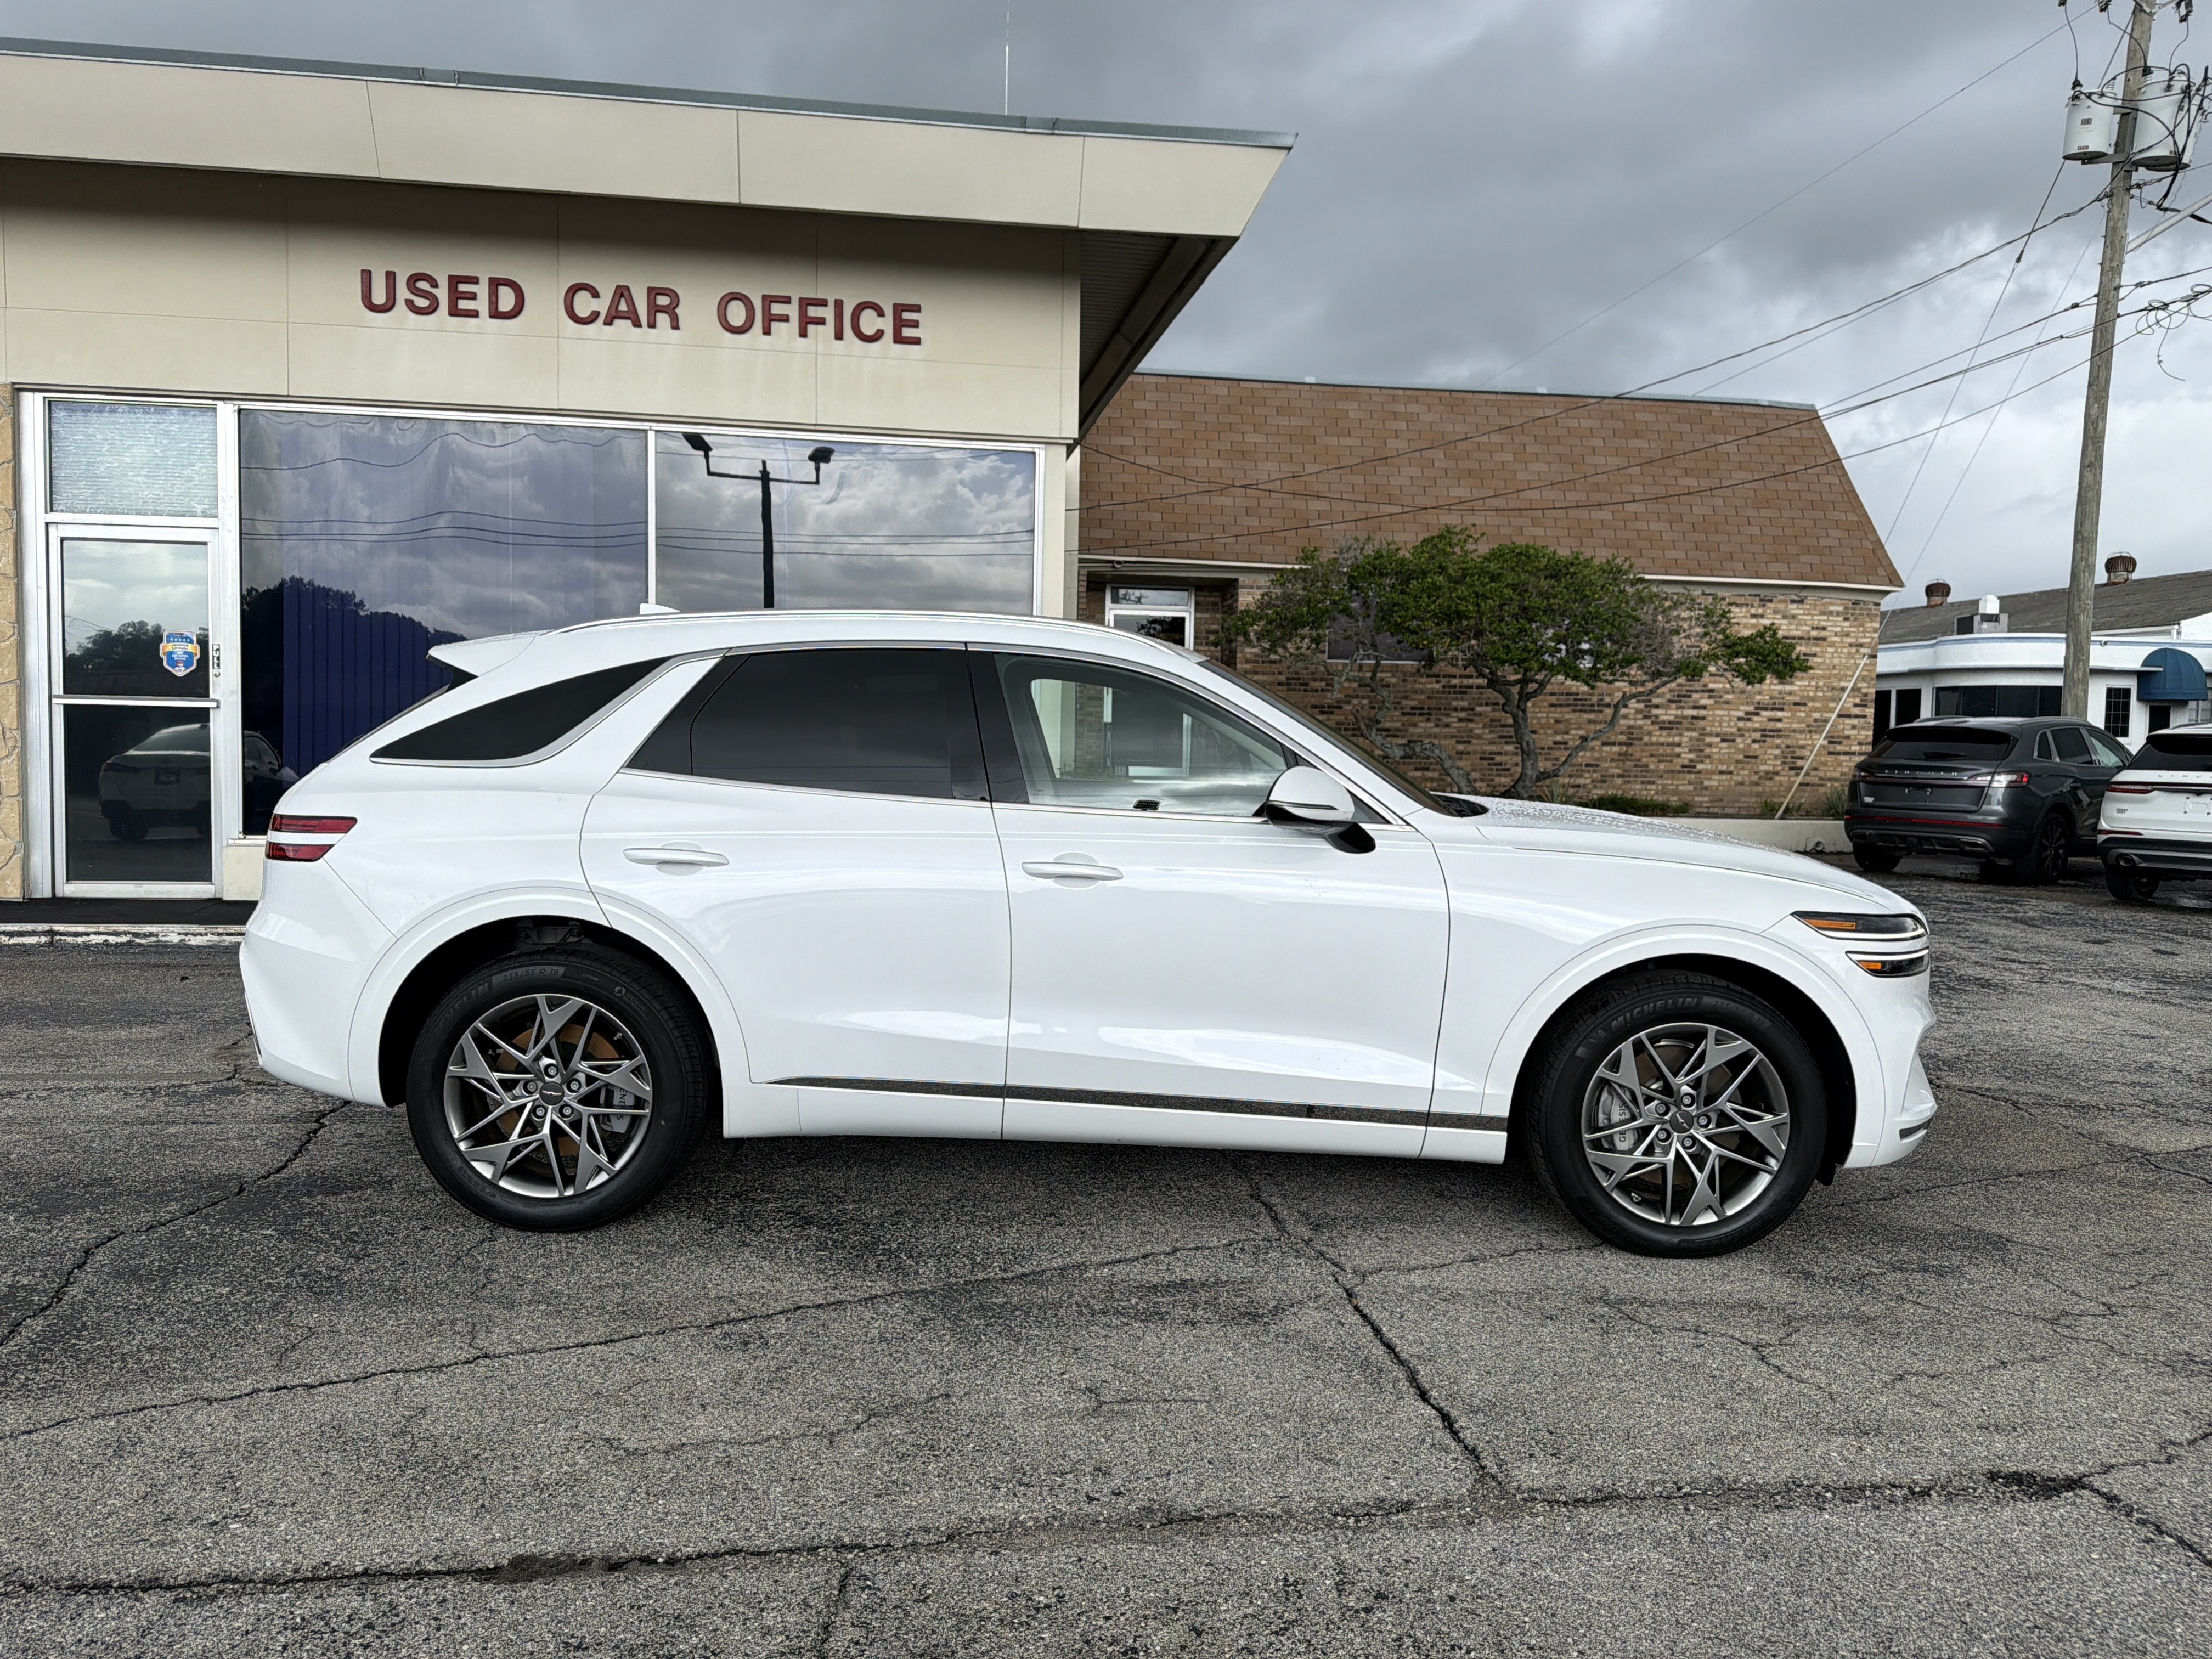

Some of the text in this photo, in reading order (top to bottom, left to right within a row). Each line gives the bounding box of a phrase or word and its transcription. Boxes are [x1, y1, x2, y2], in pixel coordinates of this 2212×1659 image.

[360, 269, 922, 345] USED CAR OFFICE
[503, 968, 537, 981] 235/55
[1611, 997, 1697, 1029] MICHELIN
